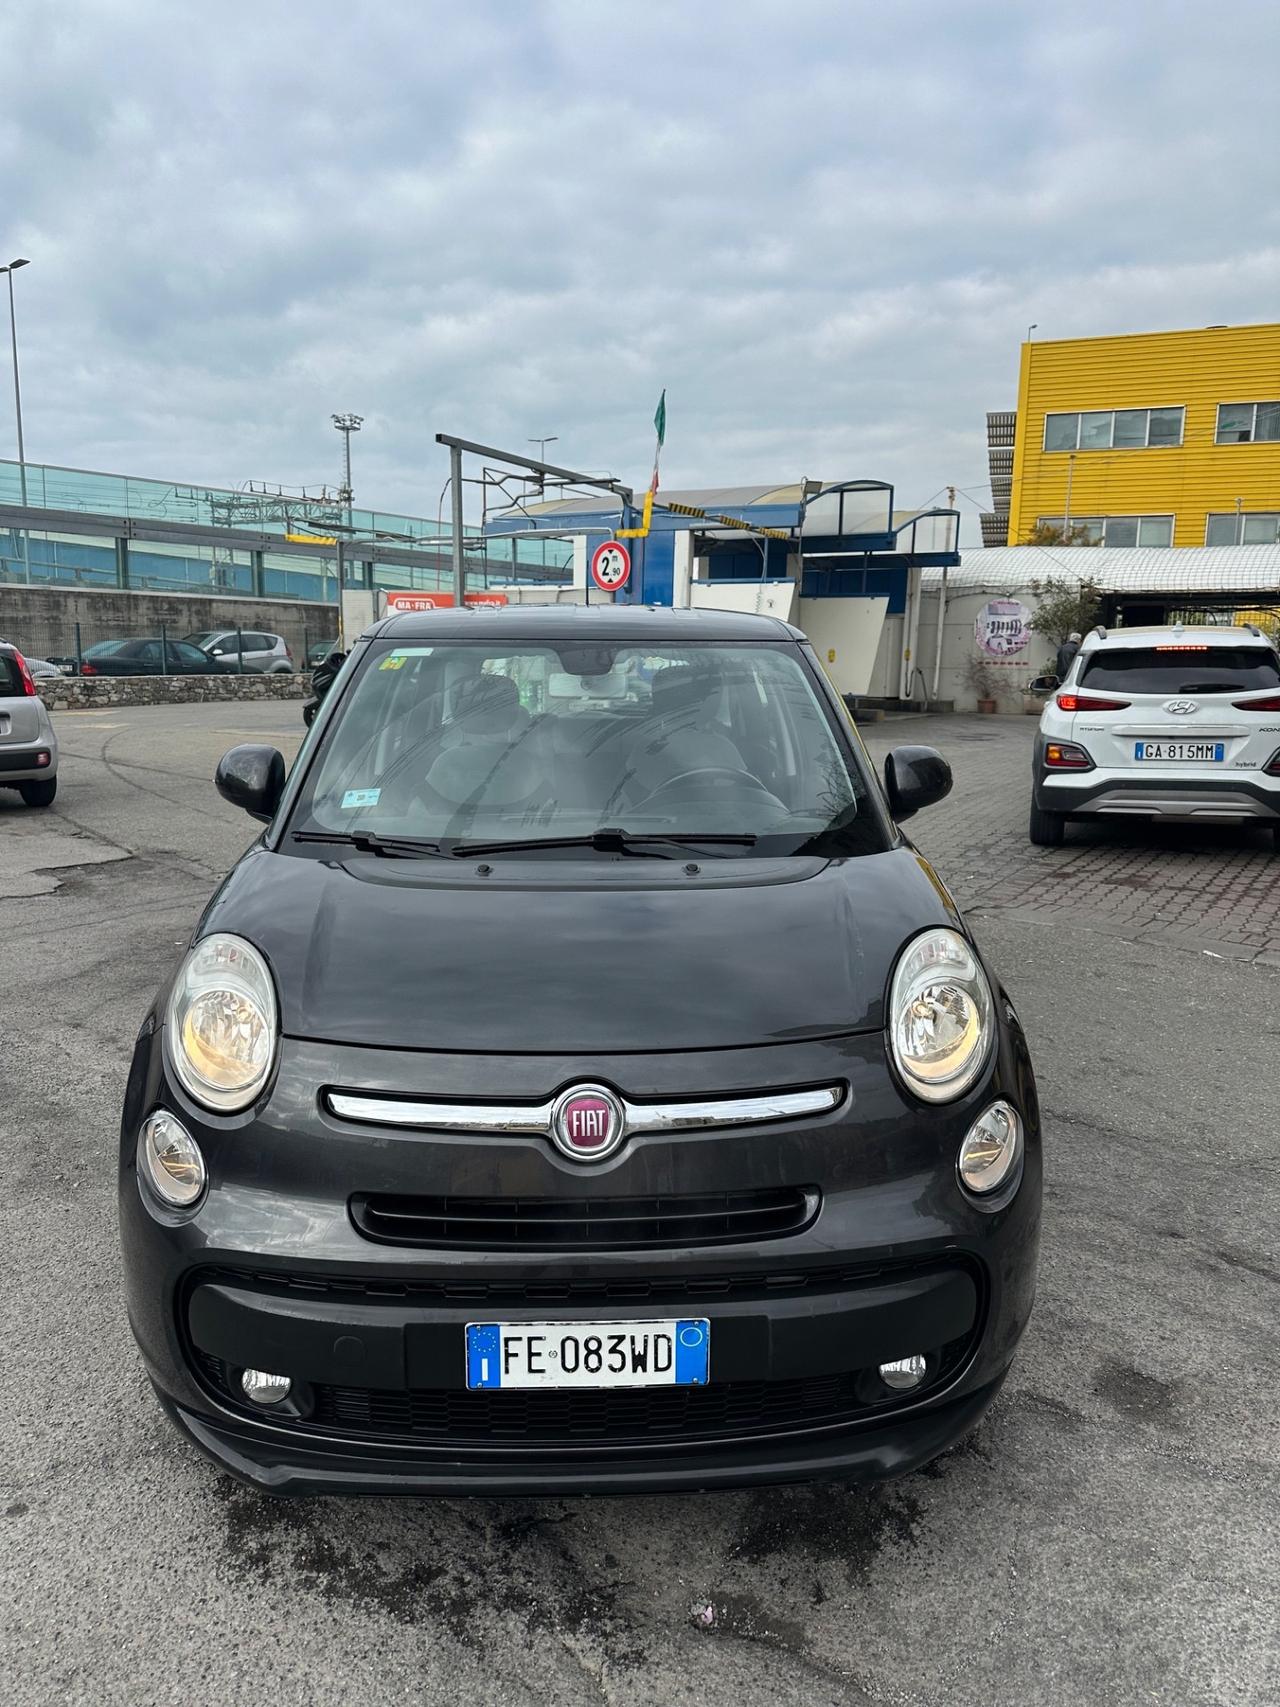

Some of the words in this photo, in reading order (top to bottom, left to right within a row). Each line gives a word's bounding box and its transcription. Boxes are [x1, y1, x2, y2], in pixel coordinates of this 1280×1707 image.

[602, 556, 610, 577] 2
[1145, 744, 1162, 758] GA
[1168, 744, 1214, 759] 815MM
[572, 1109, 606, 1137] FIAT
[503, 1335, 547, 1375] FE
[560, 1333, 673, 1374] 083WD
